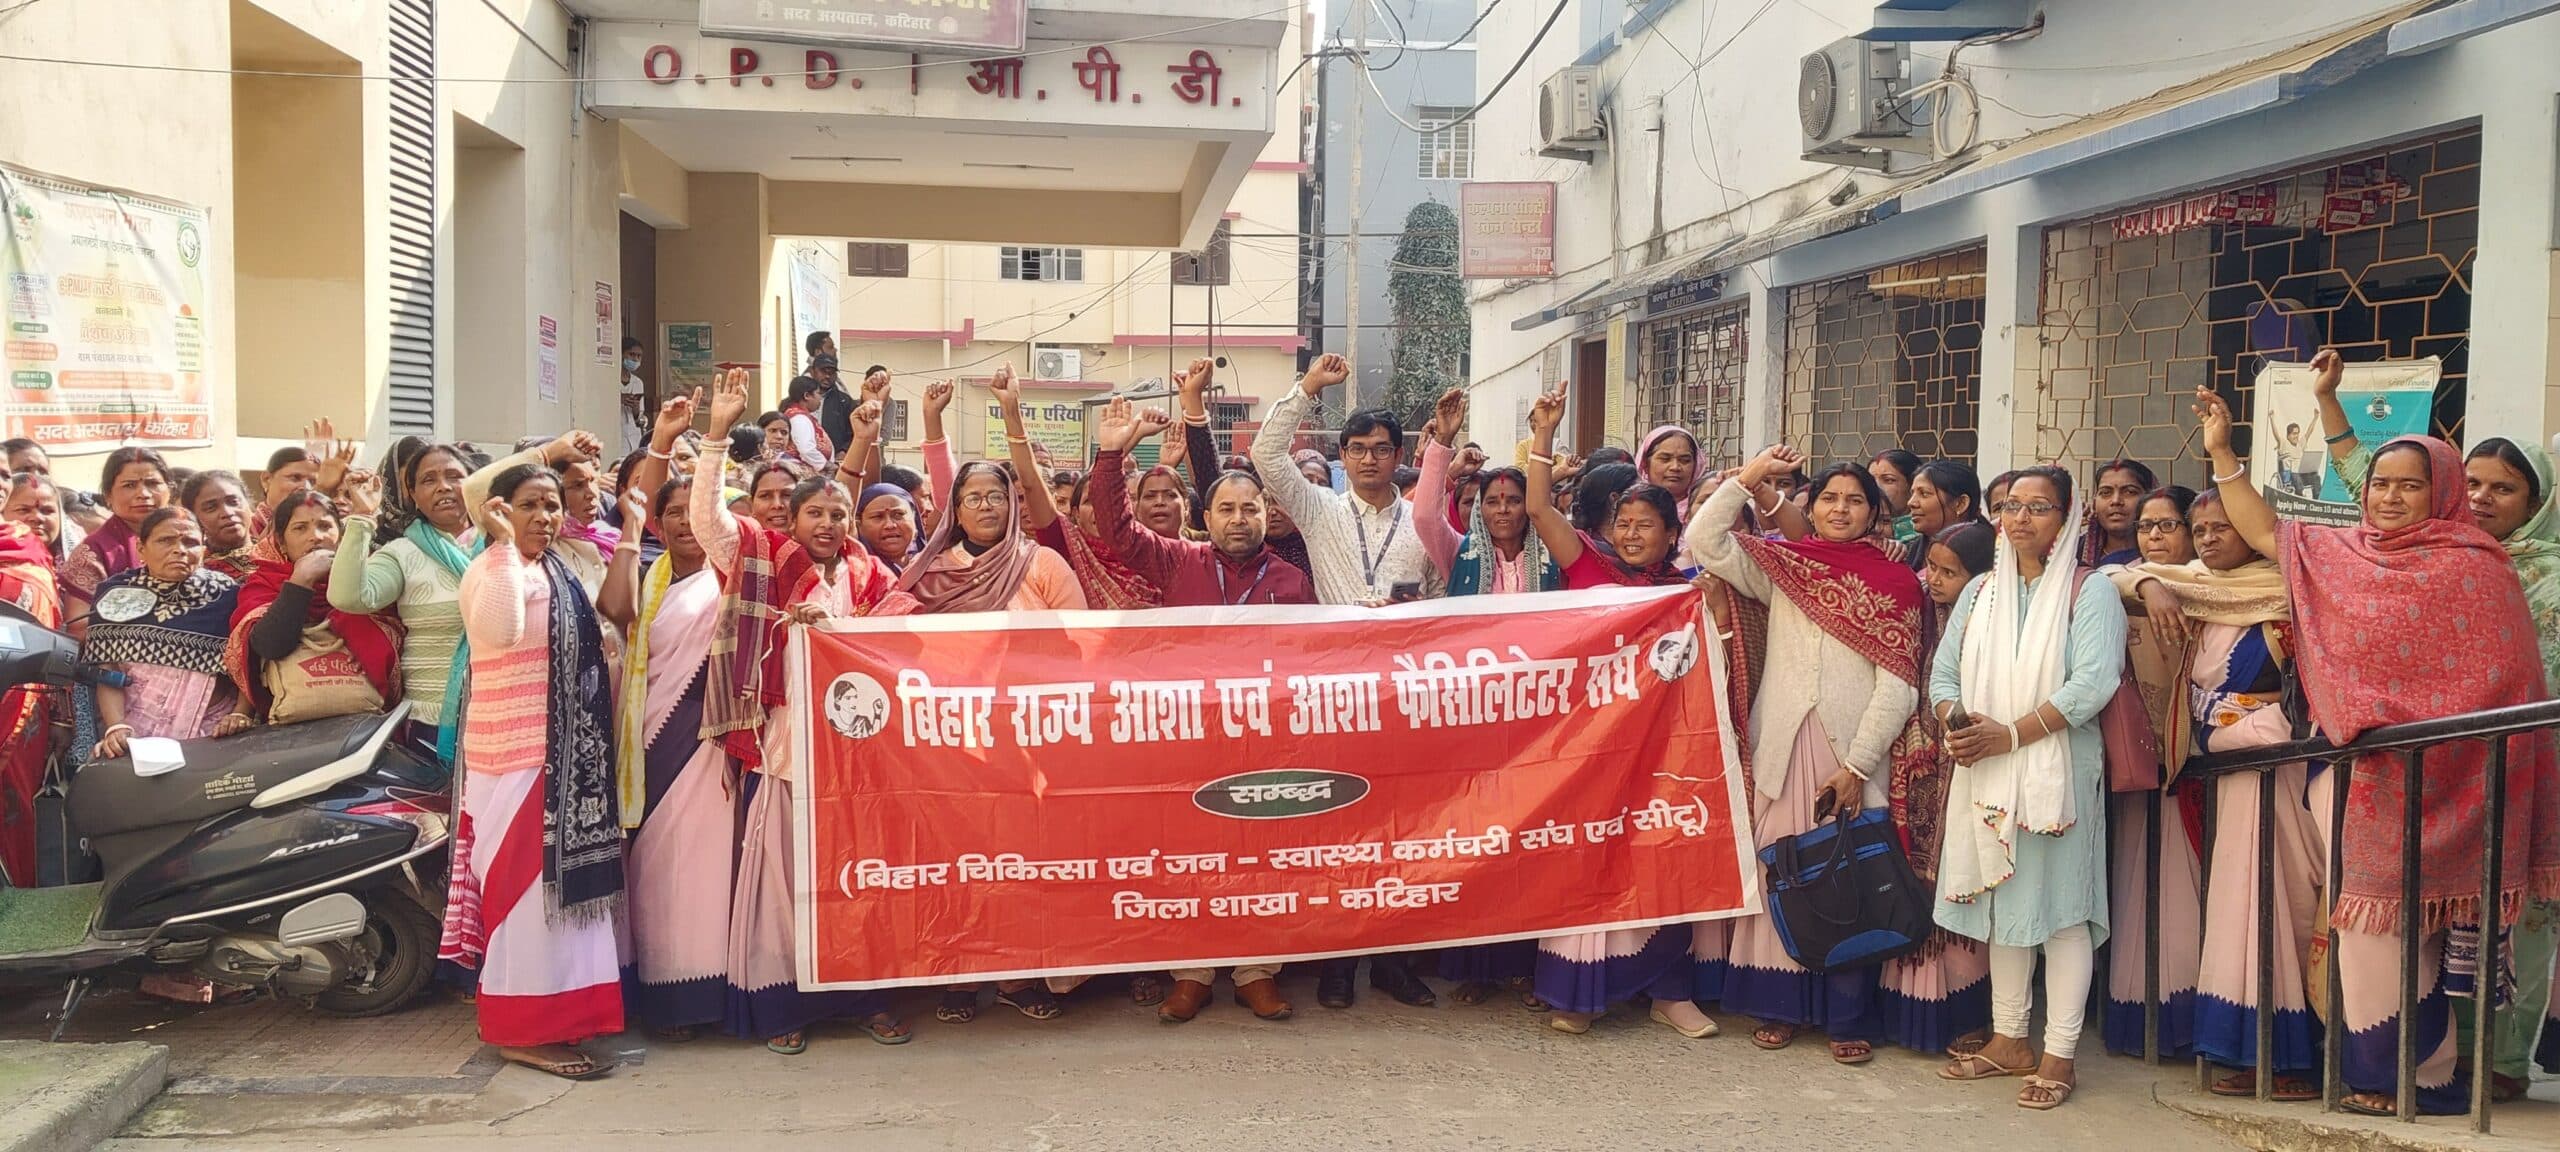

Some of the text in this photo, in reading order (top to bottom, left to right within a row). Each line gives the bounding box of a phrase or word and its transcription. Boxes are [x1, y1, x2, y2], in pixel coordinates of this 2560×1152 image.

[885, 13, 932, 30] कटिहार
[1042, 404, 1084, 422] एरिया
[33, 423, 71, 441] सदर
[2277, 499, 2292, 512] Apply
[896, 634, 1640, 749] बिहार राज्य आशा एवं आशा फैसिलिटेटर संघ
[839, 858, 951, 899] (बिहार
[956, 852, 1098, 884] चिकित्सा
[1106, 848, 1159, 881] एवं
[1163, 852, 1228, 876] जन
[1269, 839, 1384, 871] स्वास्थ्य
[1519, 818, 1575, 848] संघ
[1583, 806, 1628, 844] एवं
[1112, 890, 1201, 921] जिला
[1209, 890, 1298, 918] शाखा
[1339, 876, 1463, 911] कटिहार
